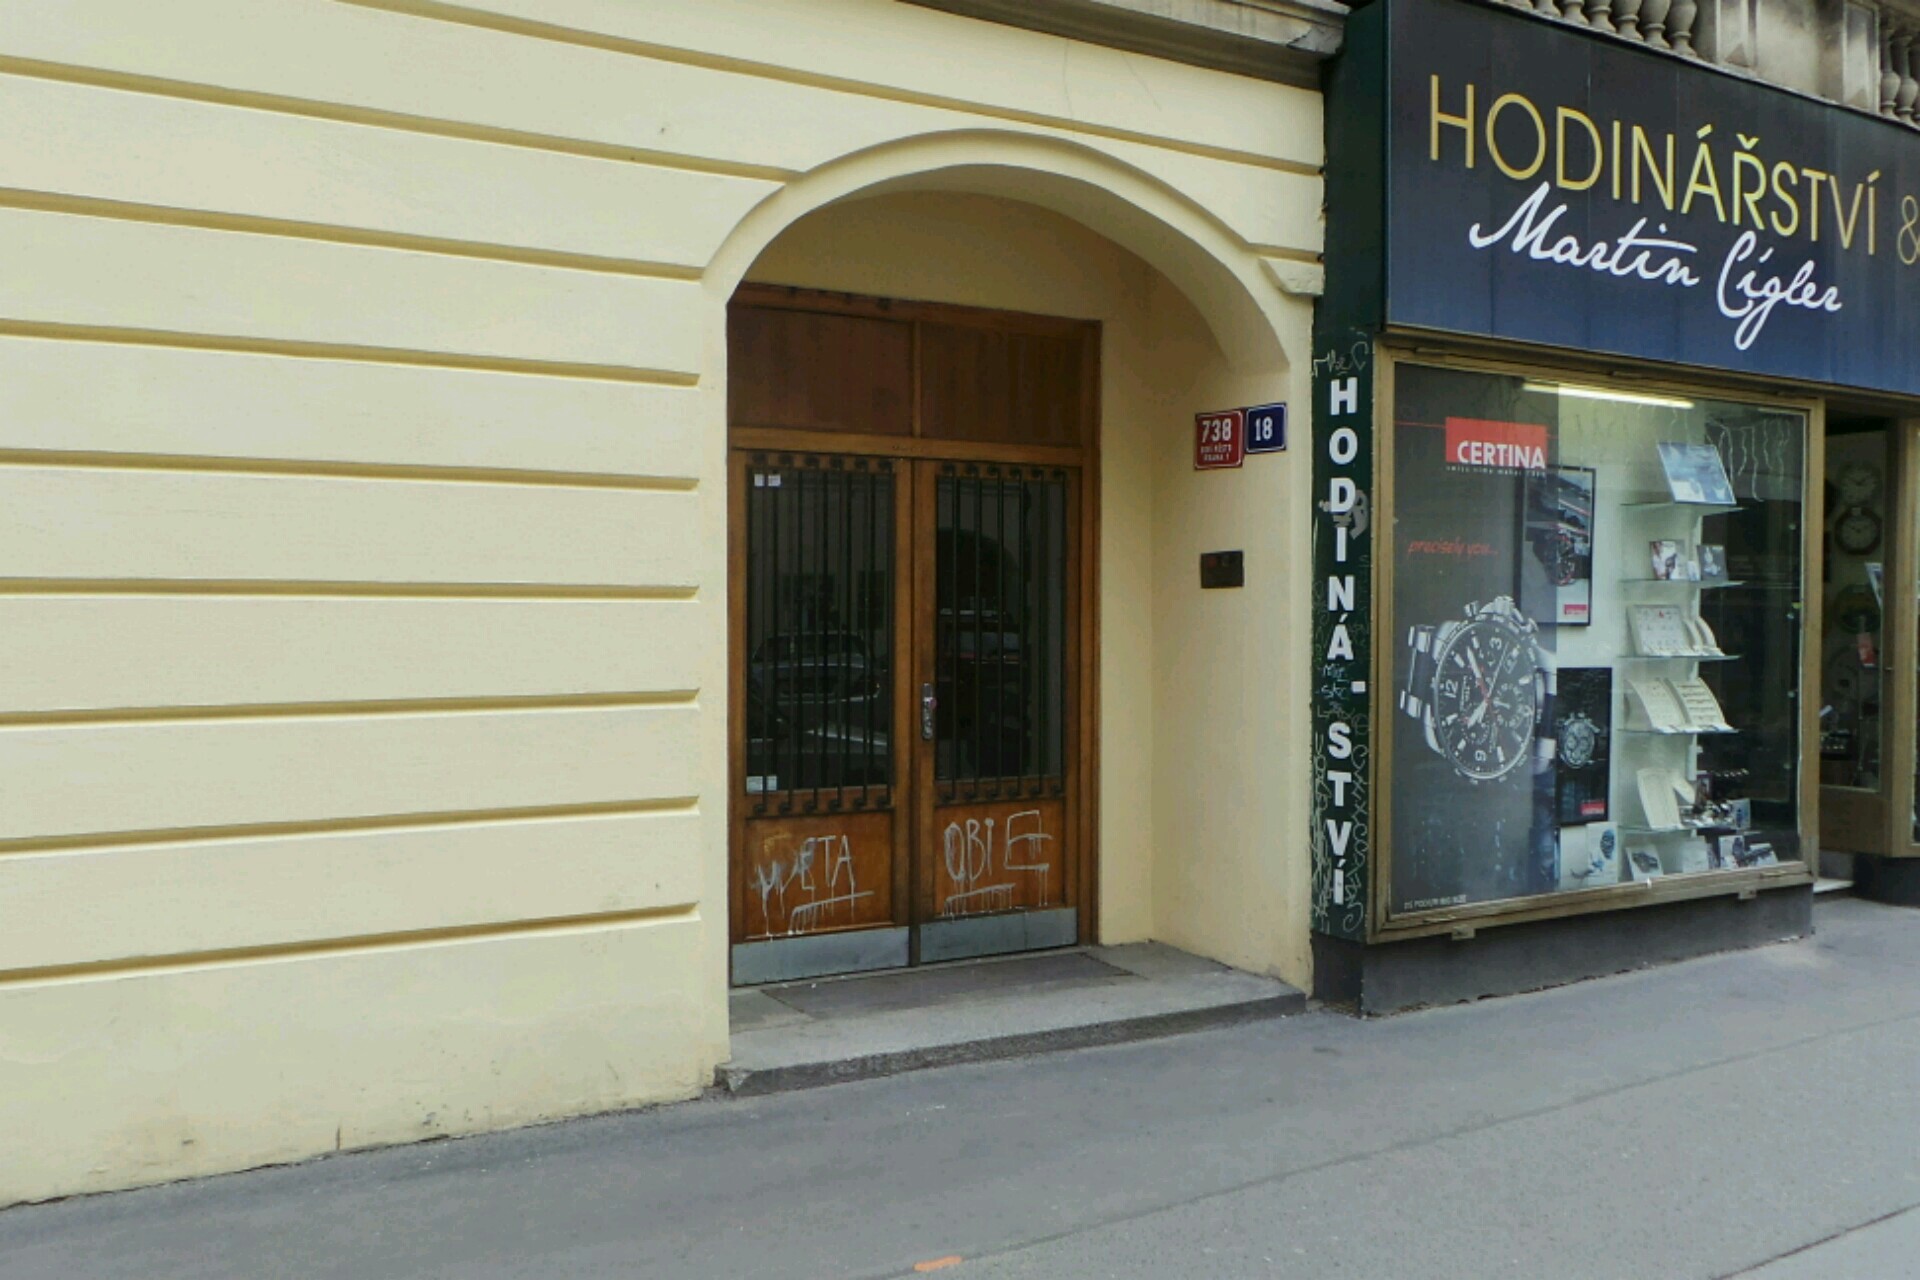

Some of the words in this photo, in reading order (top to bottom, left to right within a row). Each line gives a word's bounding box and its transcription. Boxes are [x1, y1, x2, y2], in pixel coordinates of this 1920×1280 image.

[1430, 74, 1881, 256] HODINÁŘSTVÍ
[1468, 181, 1699, 287] Martin
[1202, 418, 1232, 443] 738
[1255, 416, 1273, 441] 18
[1457, 440, 1546, 470] CERTINA
